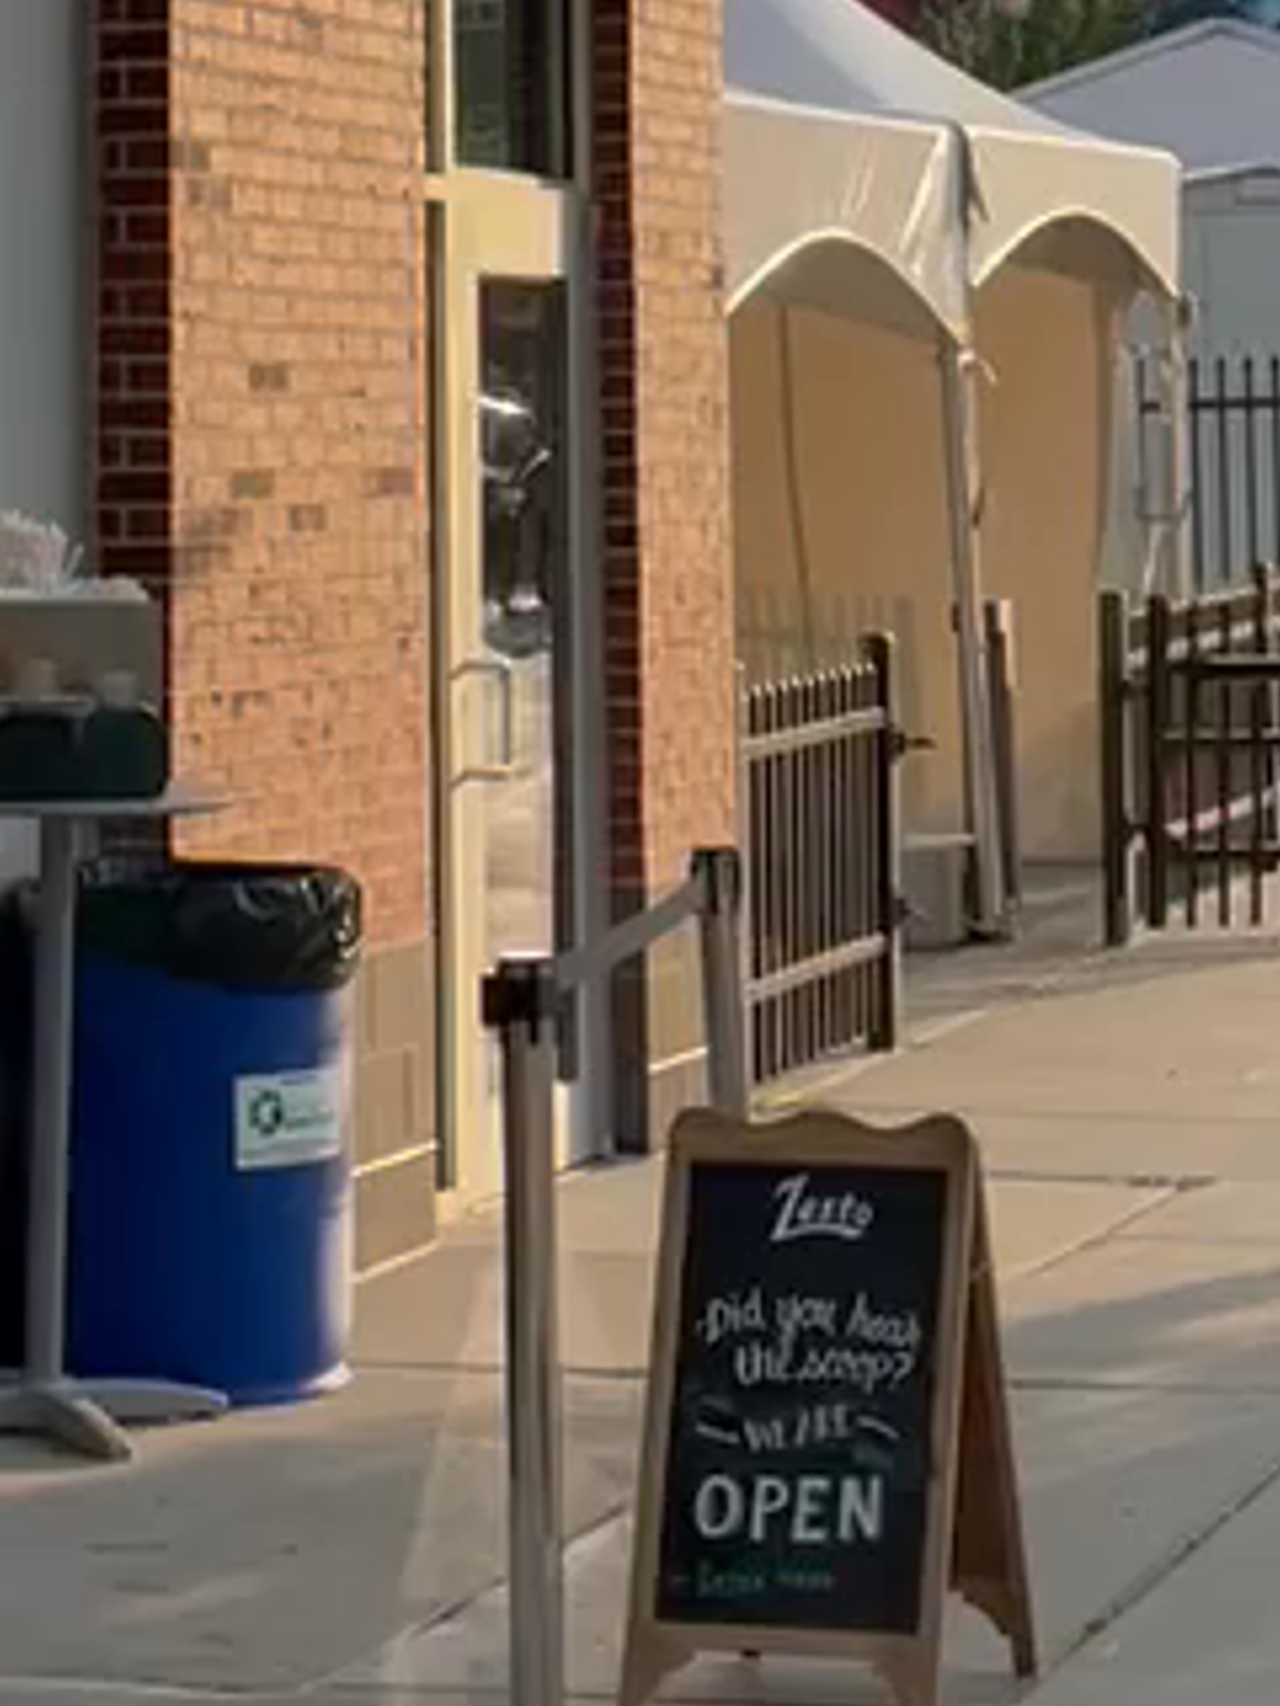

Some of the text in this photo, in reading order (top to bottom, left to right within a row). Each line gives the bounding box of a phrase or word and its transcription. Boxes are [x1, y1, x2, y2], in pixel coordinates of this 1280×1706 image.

[770, 1173, 873, 1242] Zesto
[698, 1287, 766, 1344] Did
[775, 1293, 837, 1351] you
[693, 1472, 885, 1542] OPEN
